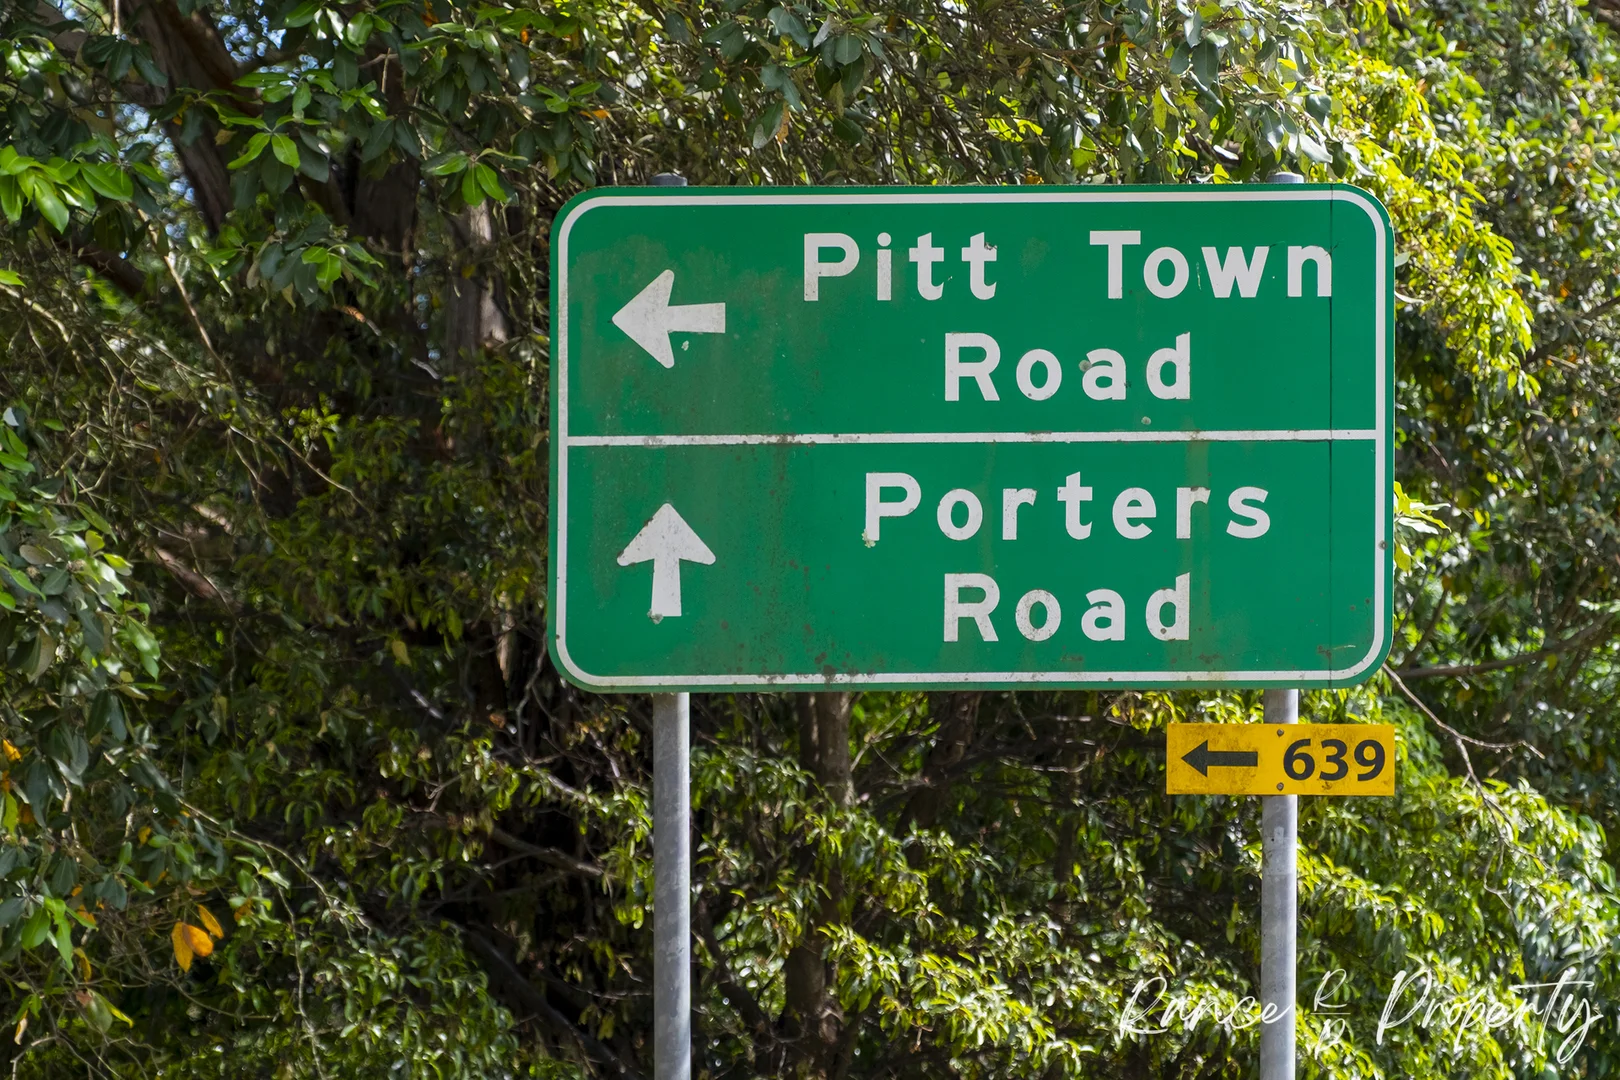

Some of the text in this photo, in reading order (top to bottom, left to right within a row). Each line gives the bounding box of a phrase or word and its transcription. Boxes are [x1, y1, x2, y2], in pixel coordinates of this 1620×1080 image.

[803, 230, 1332, 302] Pitt Town
[944, 332, 1192, 402] Road
[863, 471, 1271, 543] Porters
[943, 572, 1191, 642] Road
[1283, 738, 1386, 782] 639
